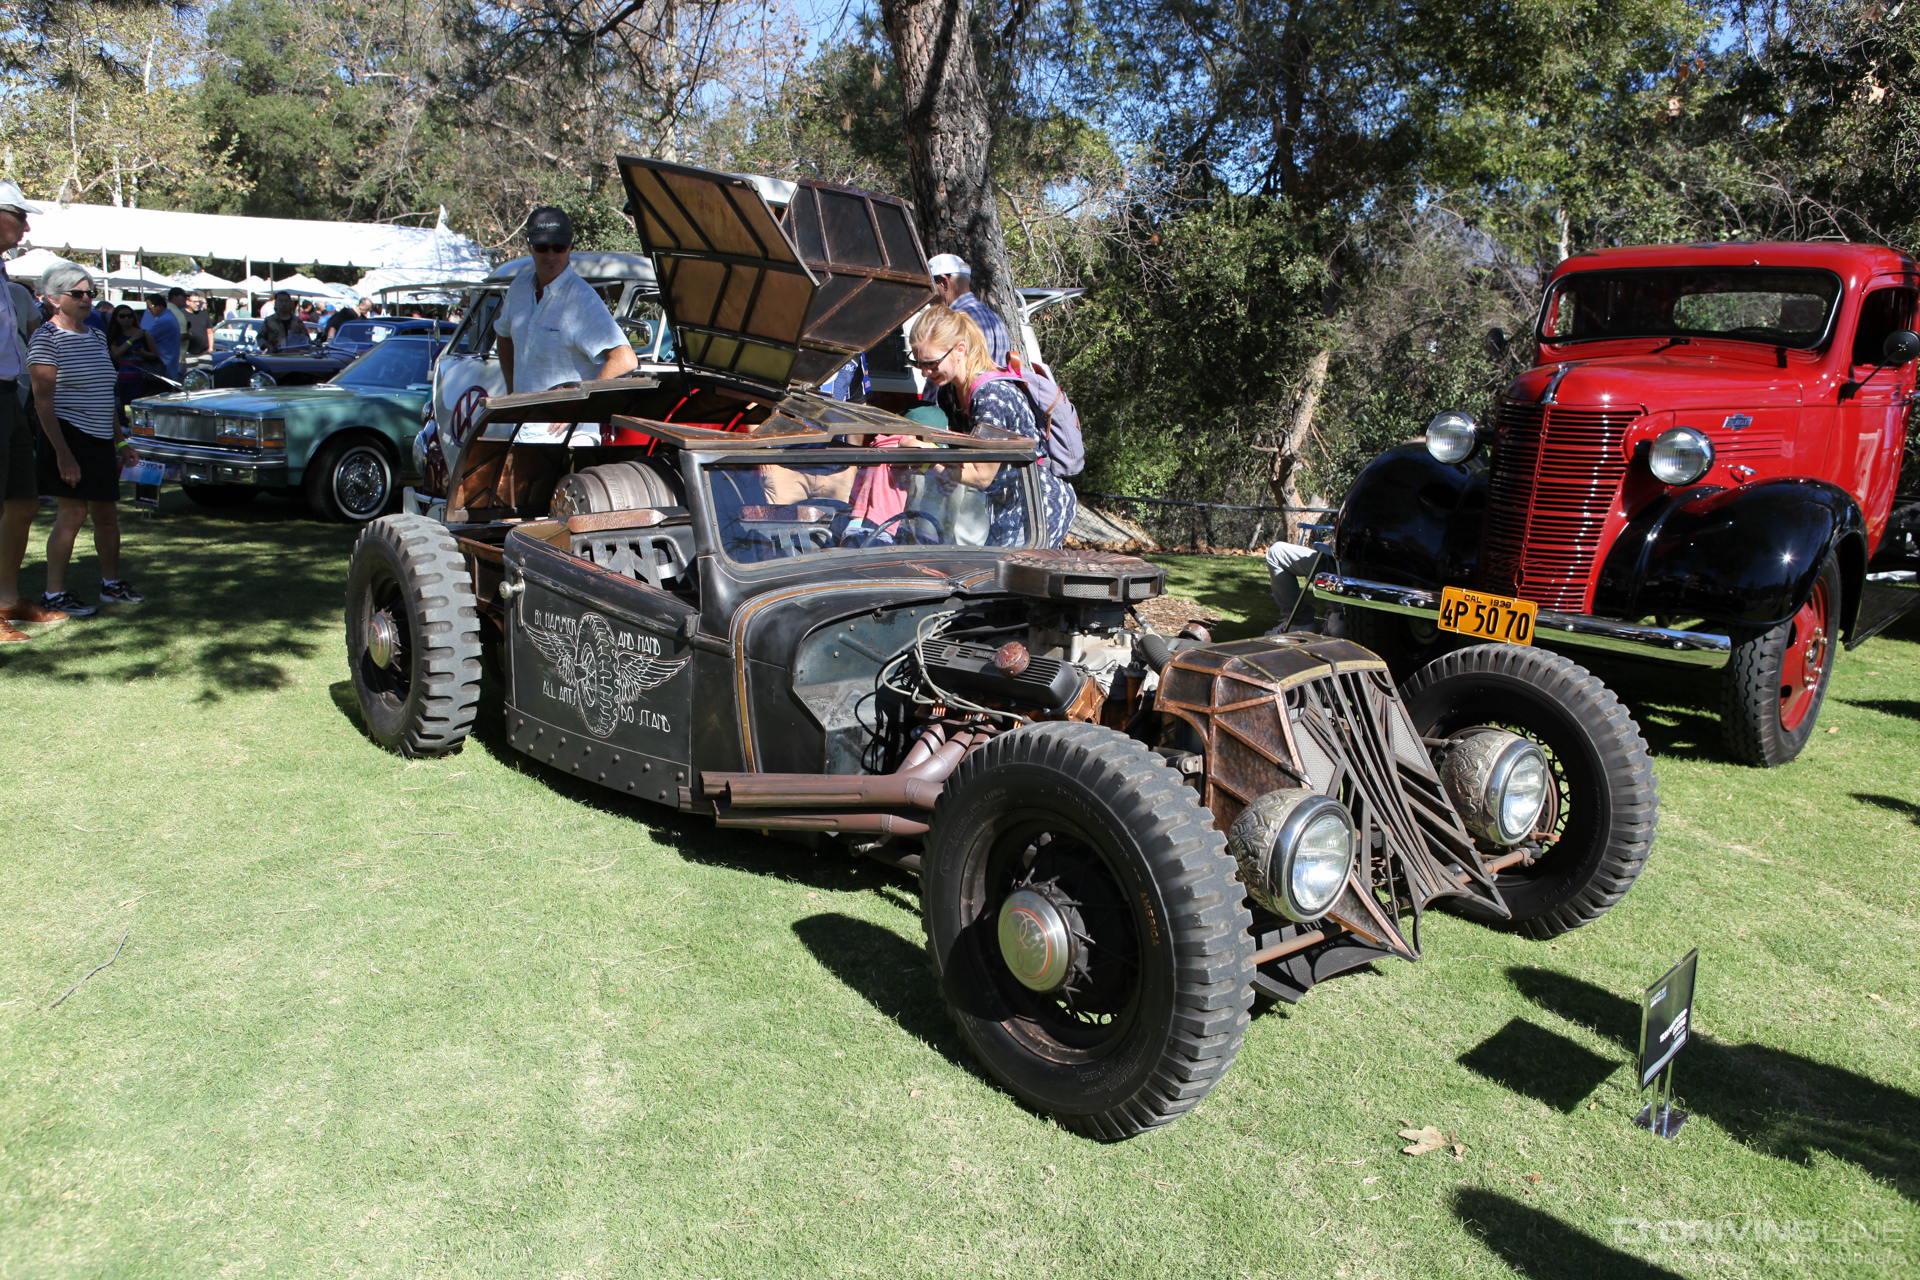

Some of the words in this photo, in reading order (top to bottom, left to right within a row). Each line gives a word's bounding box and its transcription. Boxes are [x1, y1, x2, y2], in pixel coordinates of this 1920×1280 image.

[606, 475, 625, 509] REWERY
[1441, 599, 1469, 628] 4P
[1473, 604, 1499, 635] 50
[1505, 610, 1531, 641] 70
[1464, 594, 1483, 604] CAL
[534, 609, 542, 626] BY
[545, 612, 577, 636] HAMMER
[617, 631, 634, 651] AND
[637, 635, 661, 656] HAND
[542, 680, 557, 700] ALL
[559, 685, 577, 707] ARTS
[620, 705, 635, 724] DO
[639, 709, 671, 733] STAND
[1139, 892, 1160, 947] AMERICA
